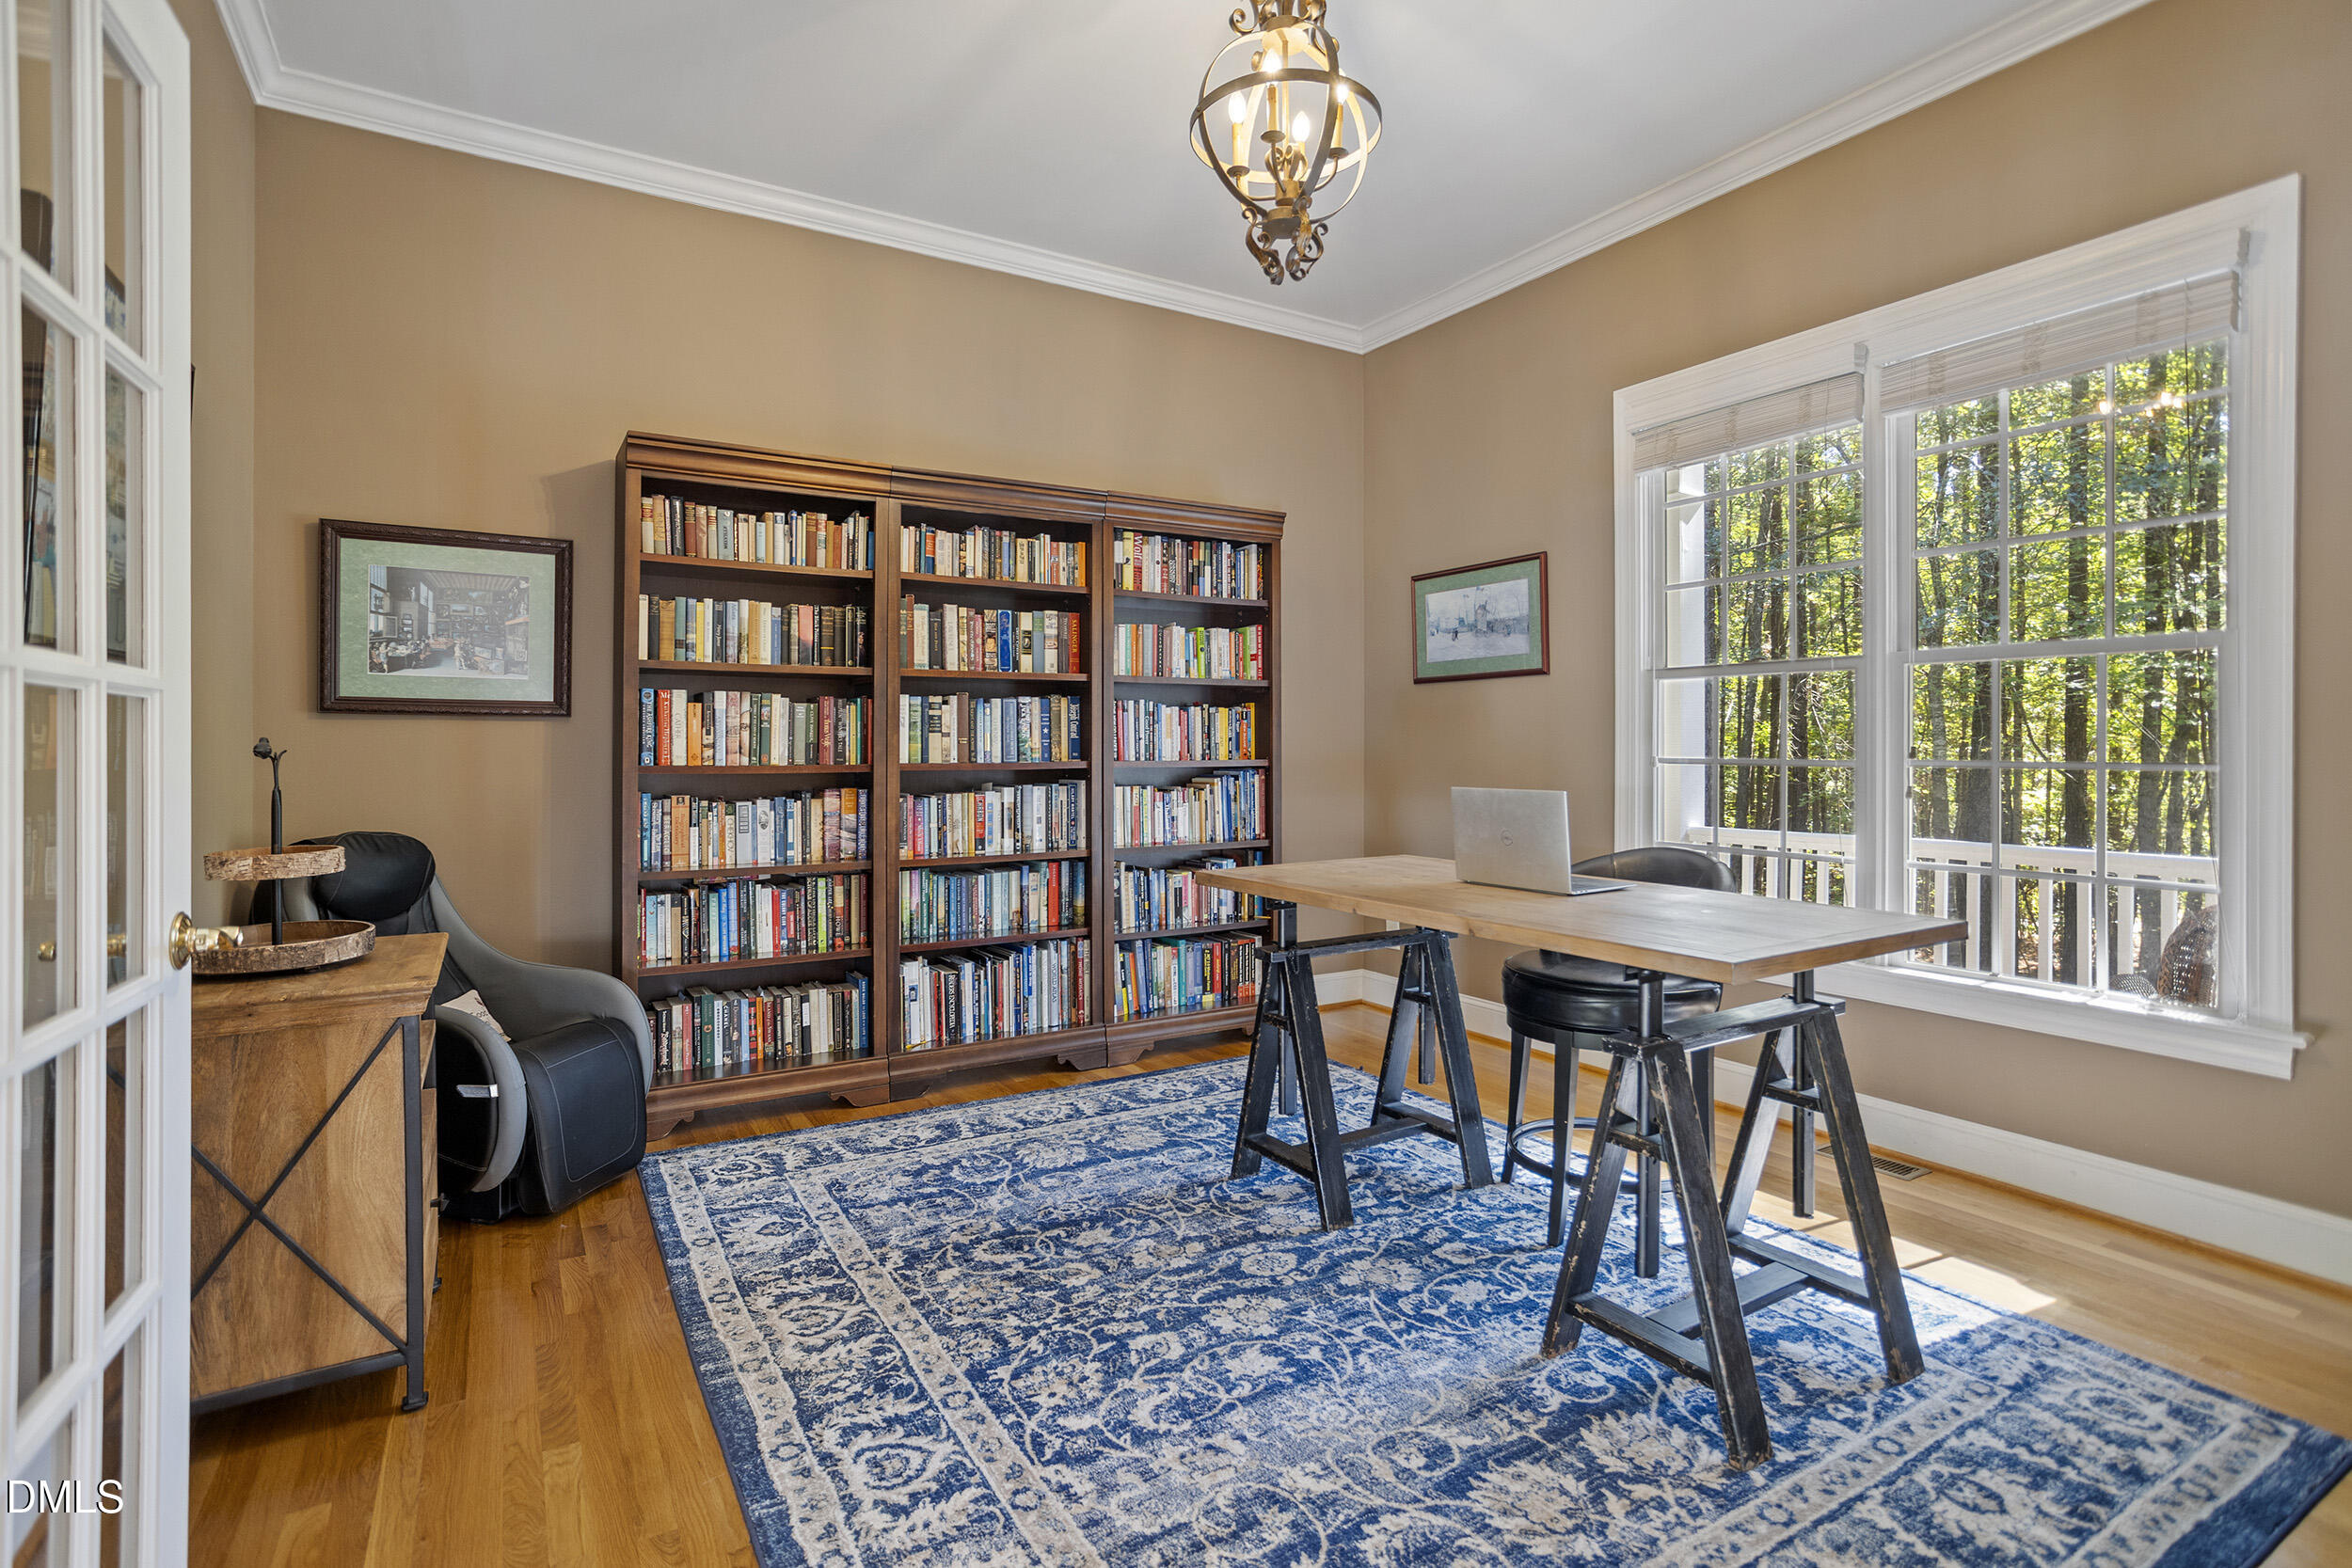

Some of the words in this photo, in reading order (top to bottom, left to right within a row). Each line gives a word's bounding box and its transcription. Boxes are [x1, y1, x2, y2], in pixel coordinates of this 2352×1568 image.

[1134, 536, 1142, 560] Wolf
[1068, 704, 1079, 721] Joseph
[1070, 721, 1078, 739] Conrad
